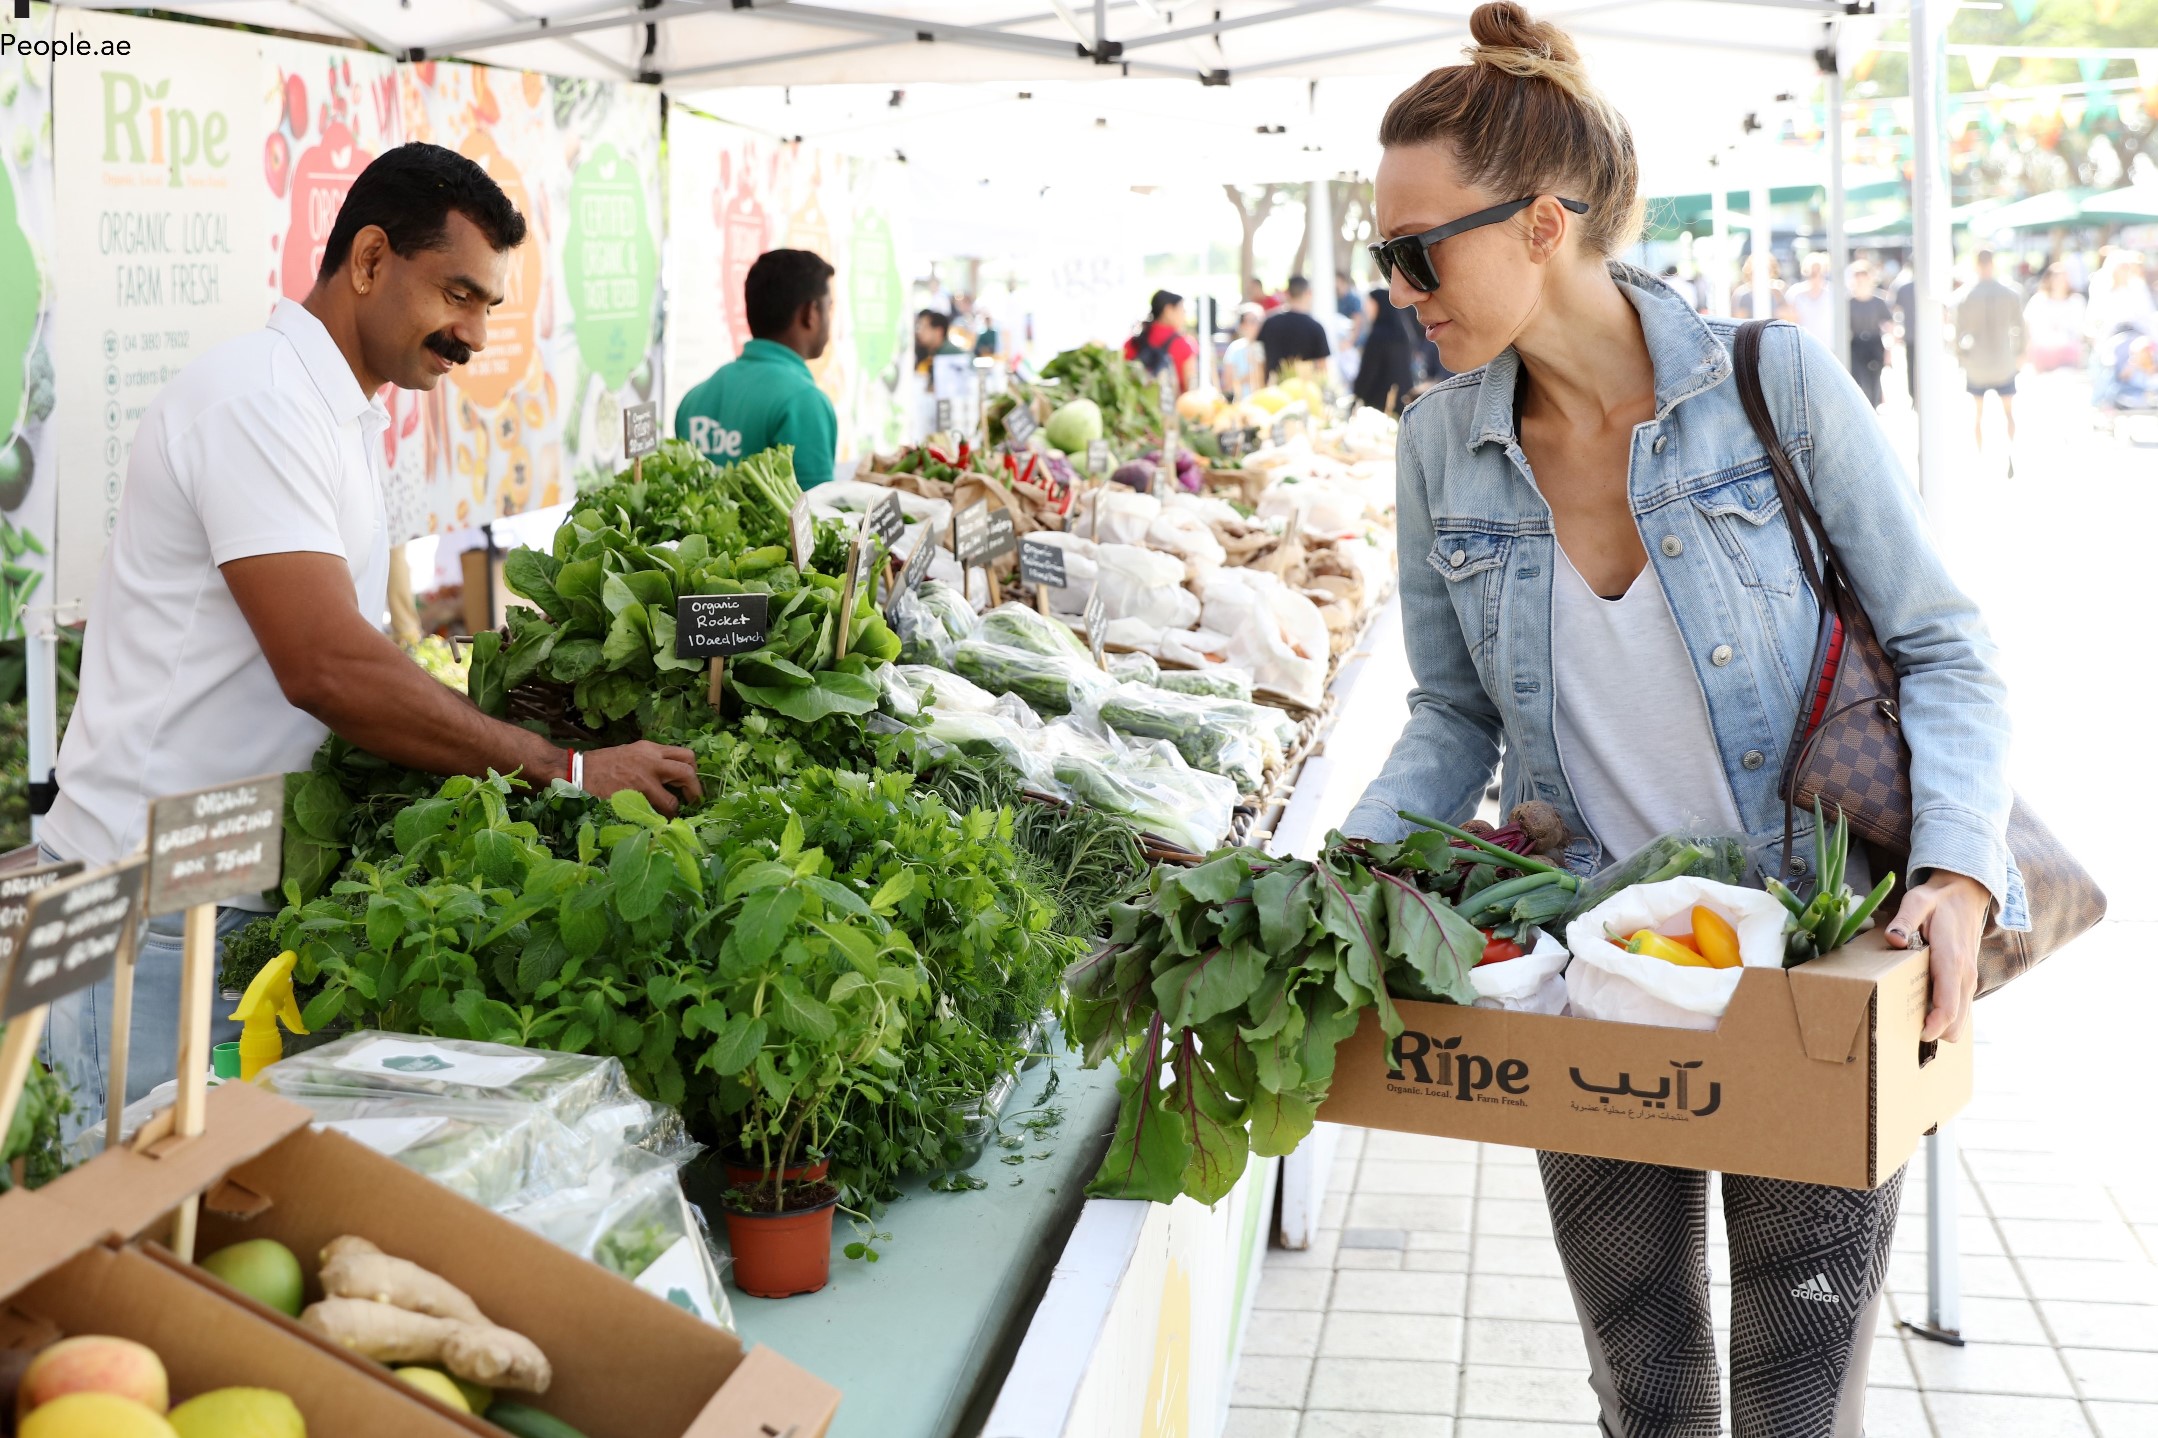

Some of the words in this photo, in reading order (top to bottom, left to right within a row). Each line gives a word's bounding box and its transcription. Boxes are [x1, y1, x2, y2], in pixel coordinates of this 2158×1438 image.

[100, 71, 230, 188] Ripe
[691, 601, 740, 616] Organic
[696, 613, 751, 629] Rocket
[210, 808, 274, 839] JUICING
[1386, 1031, 1530, 1101] Ripe
[1386, 1083, 1423, 1095] Organic.
[1425, 1087, 1452, 1099] Local.
[1476, 1093, 1499, 1104] Farm
[1501, 1096, 1528, 1107] Fresh.
[1791, 1288, 1840, 1303] adidas
